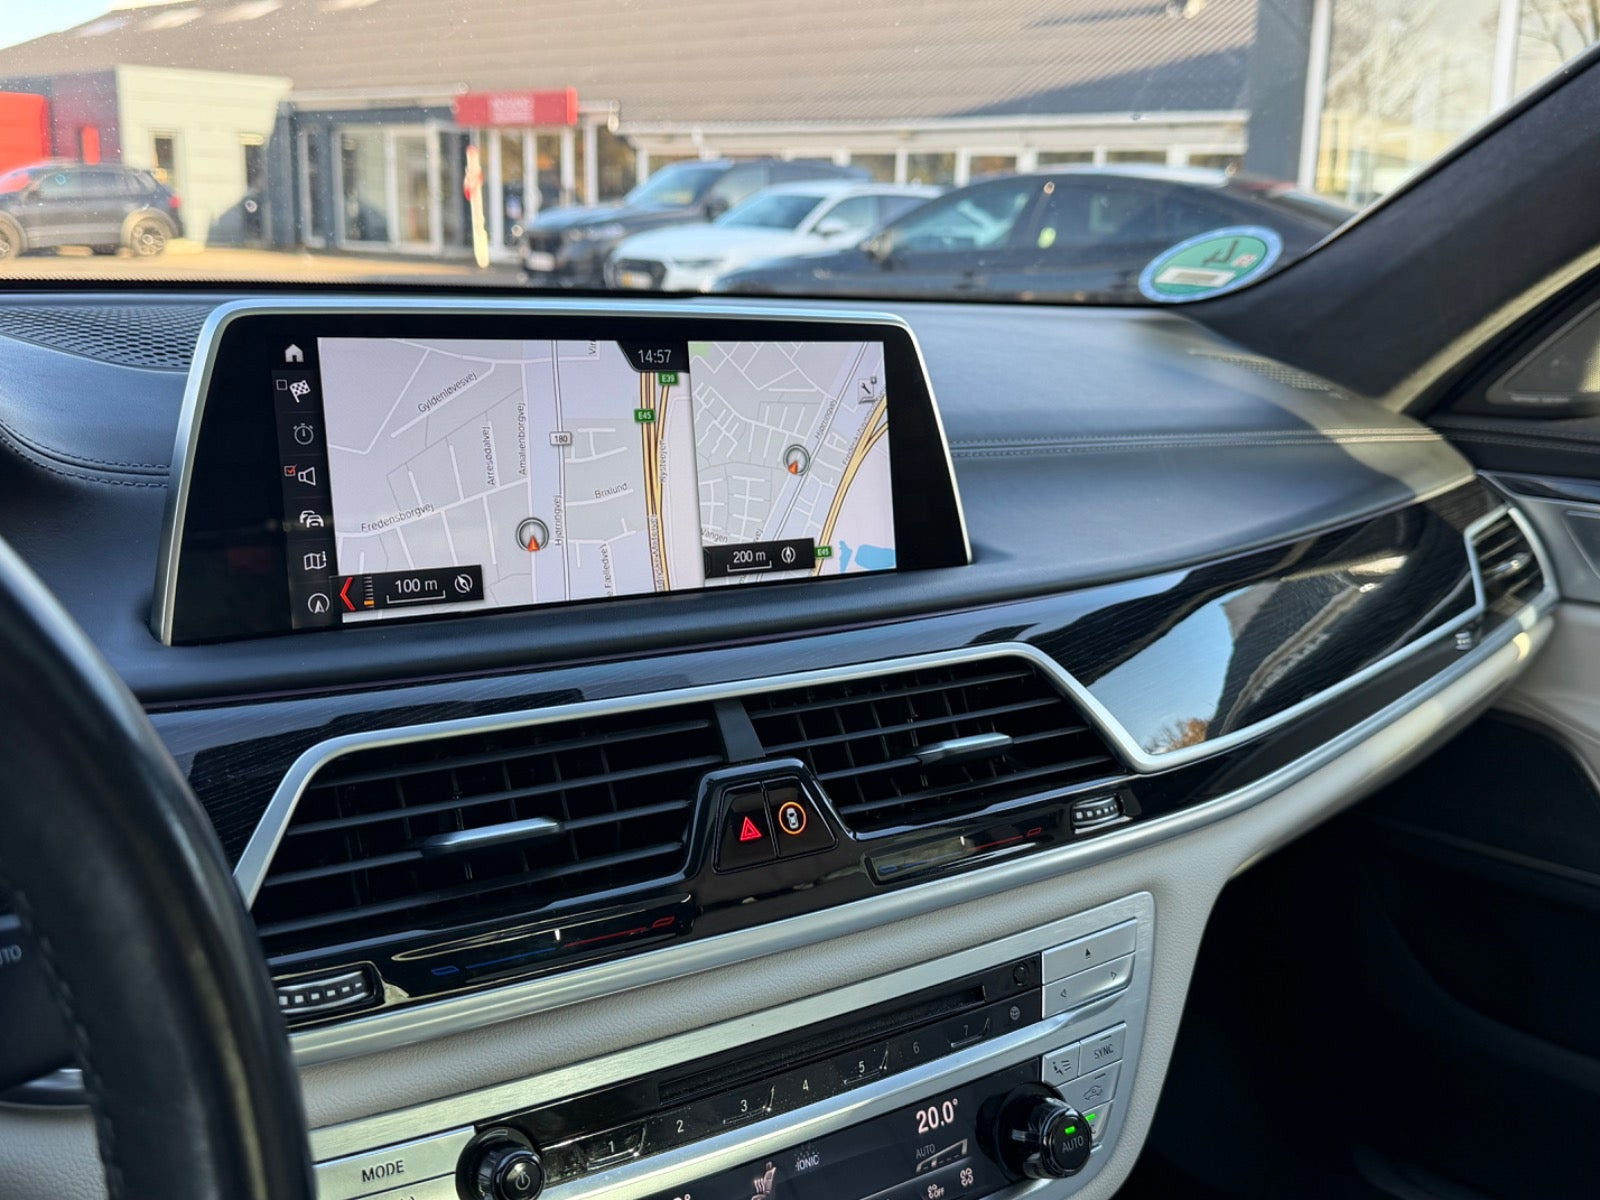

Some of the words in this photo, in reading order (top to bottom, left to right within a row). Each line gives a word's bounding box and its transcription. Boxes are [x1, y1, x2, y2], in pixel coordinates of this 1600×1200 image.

[637, 349, 672, 364] 14:57
[661, 374, 675, 383] E39
[638, 411, 652, 420] E45
[518, 402, 526, 476] Amalienborgvej
[554, 435, 568, 443] 180
[594, 482, 628, 499] Brixlund
[360, 502, 435, 533] Fredensborgvej
[733, 550, 753, 563] 200
[755, 551, 766, 561] m
[394, 578, 421, 593] 100
[424, 580, 438, 591] m
[0, 945, 22, 964] TO
[912, 1041, 920, 1054] 6
[1094, 1043, 1114, 1059] SYNC
[858, 1060, 865, 1073] 5
[802, 1079, 809, 1092] 4
[740, 1099, 748, 1112] 3
[916, 1098, 958, 1134] 20.0°
[676, 1119, 685, 1133] 2
[608, 1140, 614, 1152] 1
[915, 1143, 936, 1159] AUTO
[1061, 1135, 1084, 1154] AUTO
[361, 1160, 405, 1182] MODE
